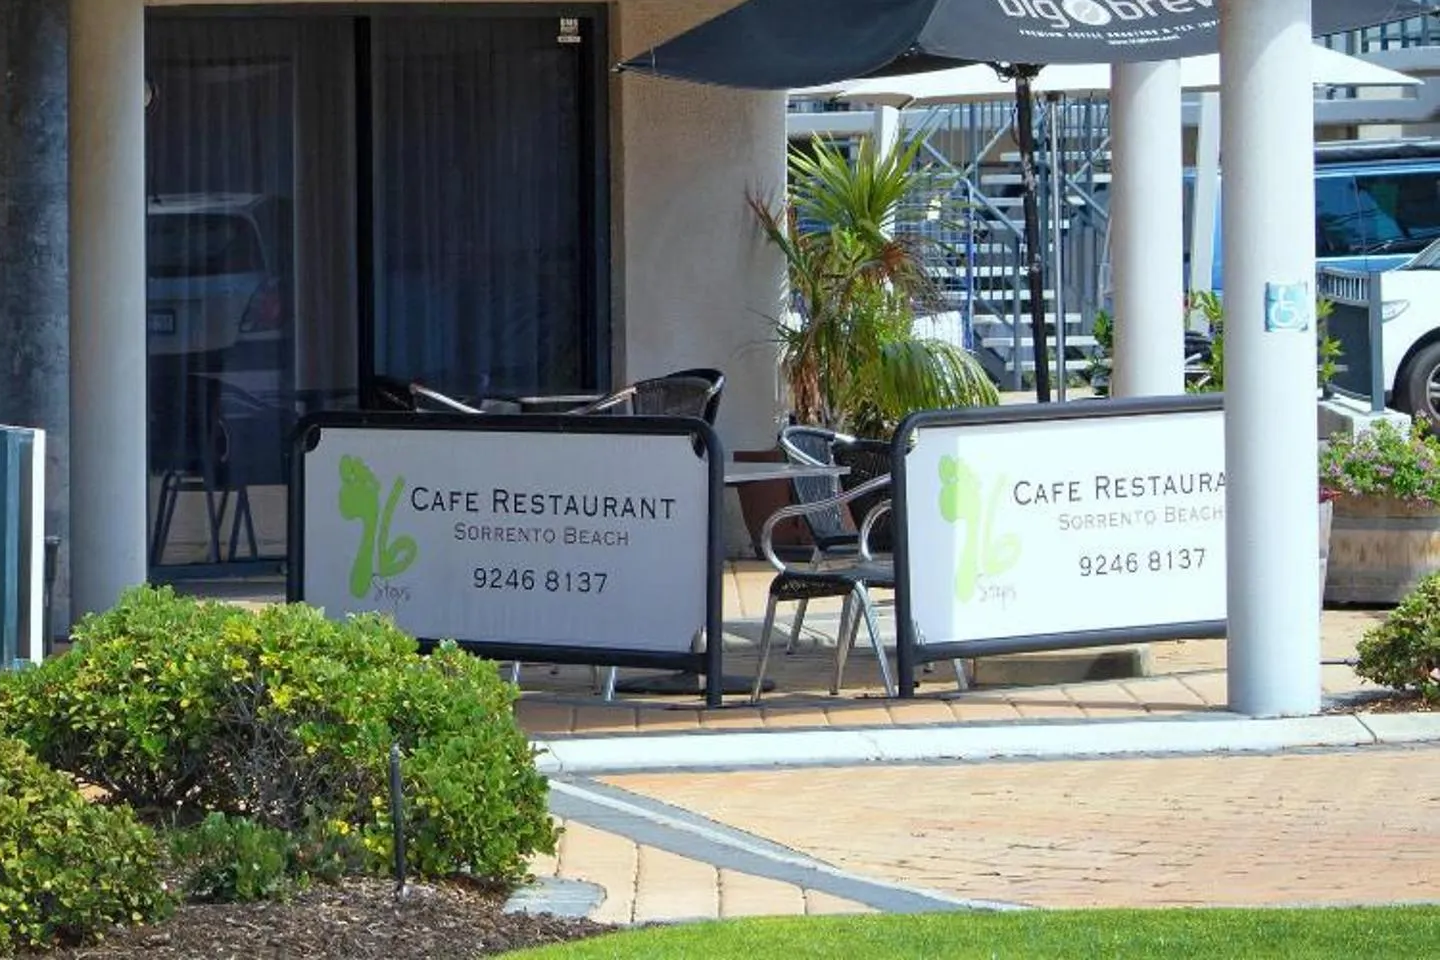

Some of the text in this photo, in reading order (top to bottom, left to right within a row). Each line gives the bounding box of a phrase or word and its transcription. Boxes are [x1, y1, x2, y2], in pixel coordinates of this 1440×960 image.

[411, 486, 677, 520] CAFE RESTAURANT
[1013, 480, 1082, 506] CAFE
[1059, 509, 1157, 531] SORRENTO
[454, 523, 631, 548] SORRENTO BEACH
[1079, 548, 1207, 578] 9246 8137
[473, 567, 608, 595] 9246 8137
